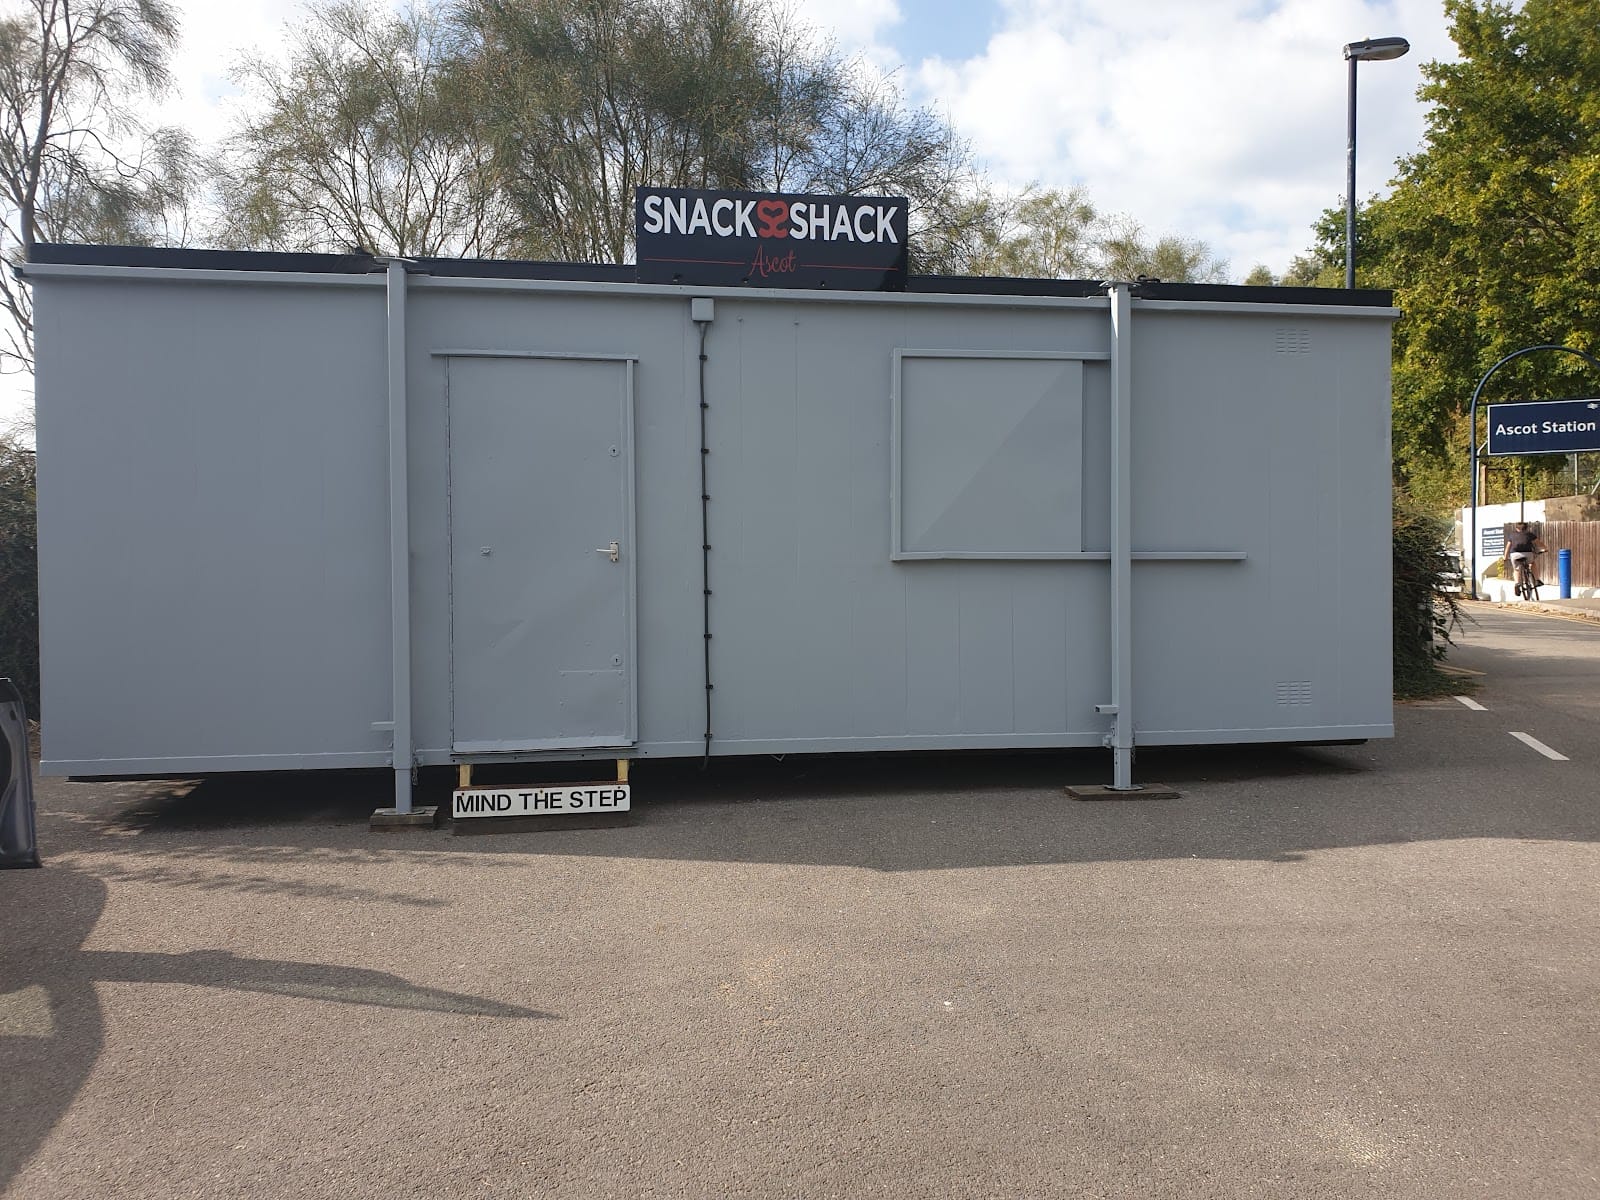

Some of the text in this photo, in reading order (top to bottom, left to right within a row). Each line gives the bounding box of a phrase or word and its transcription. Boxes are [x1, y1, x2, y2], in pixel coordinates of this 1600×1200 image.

[643, 195, 899, 244] SNACK SHACK
[749, 244, 796, 278] Ascot
[1495, 420, 1596, 436] Ascot Station
[456, 790, 627, 813] MIND THE STEP
